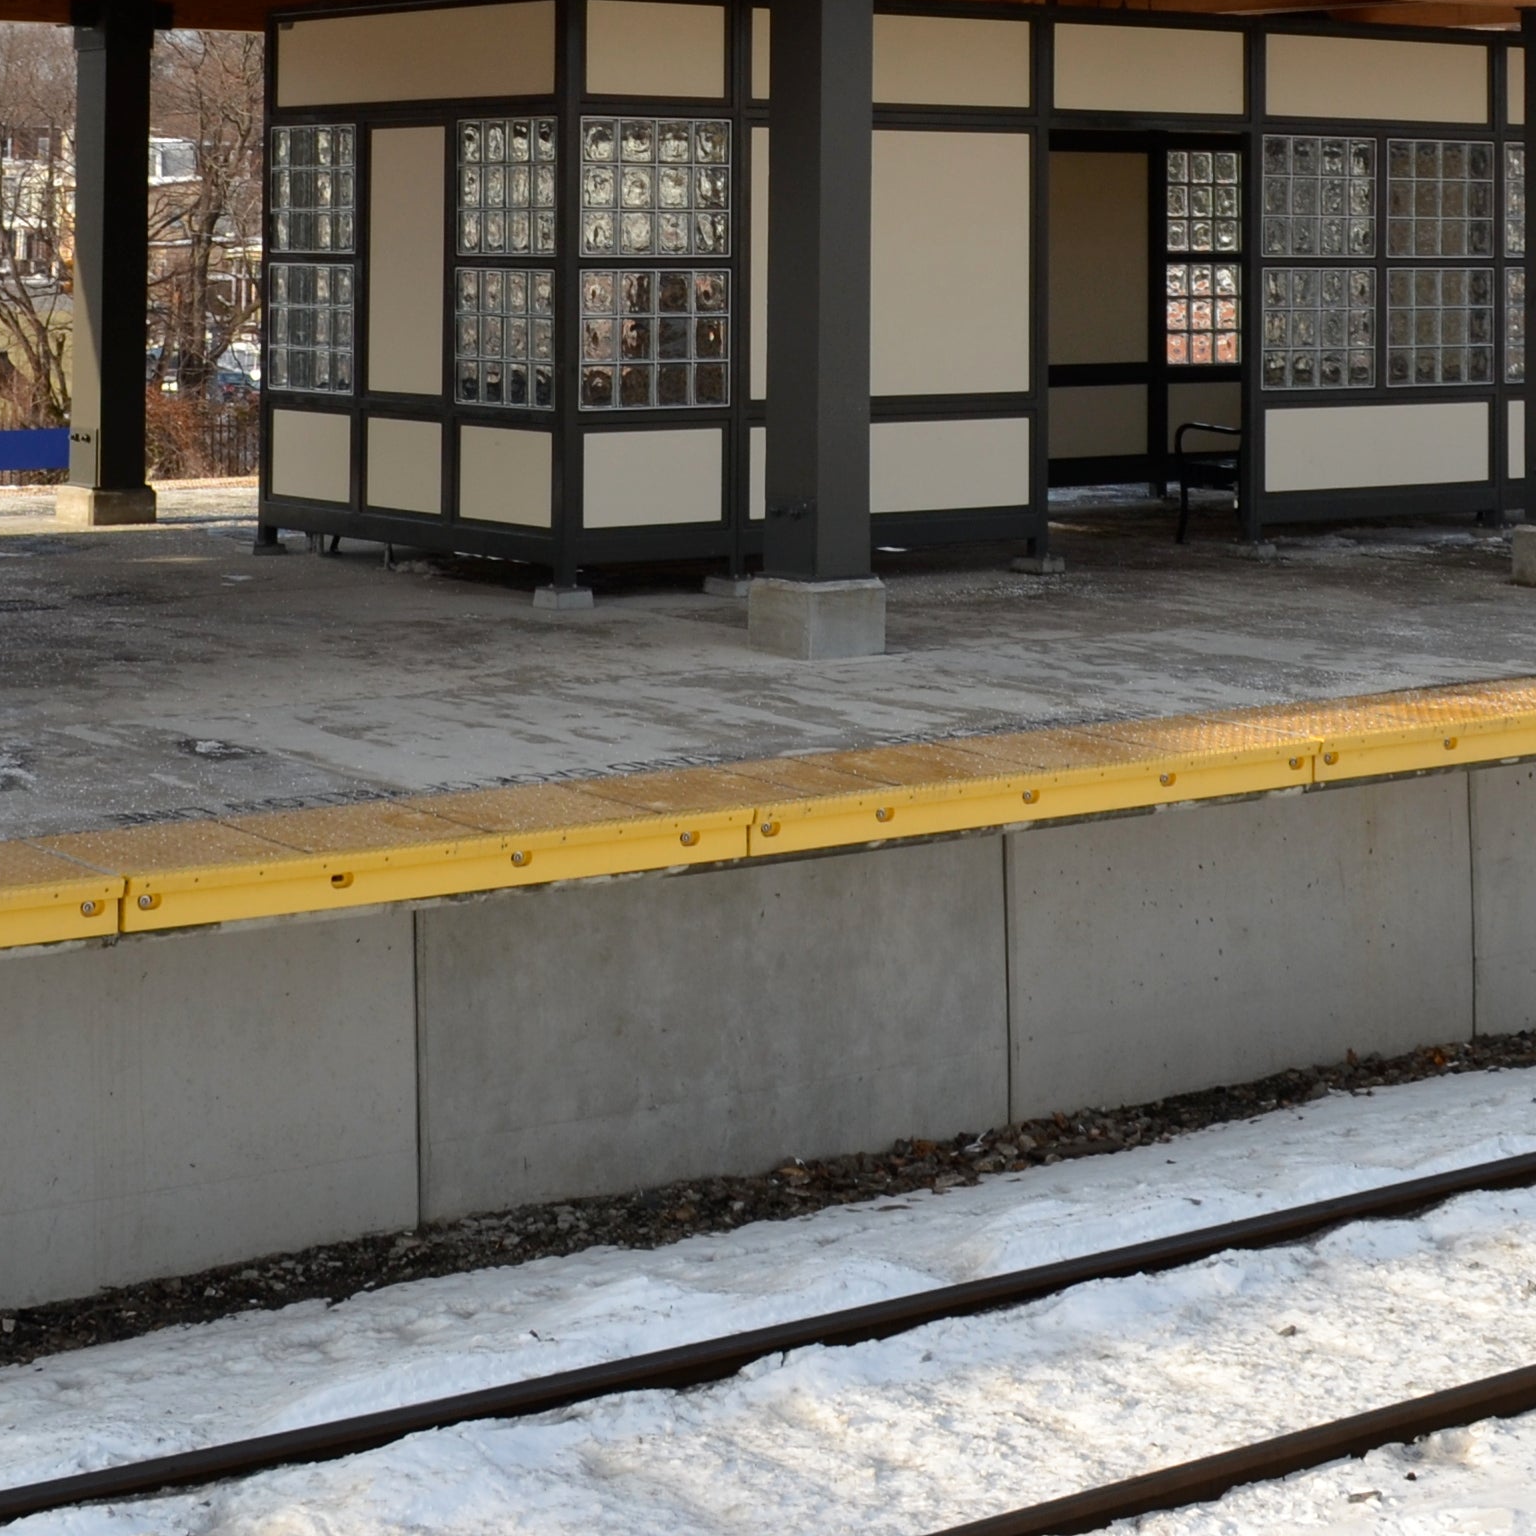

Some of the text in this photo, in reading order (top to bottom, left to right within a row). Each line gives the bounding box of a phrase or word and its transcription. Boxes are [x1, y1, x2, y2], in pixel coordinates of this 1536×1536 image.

[480, 766, 605, 786] BACK
[421, 779, 480, 794] OF
[221, 789, 414, 813] YELLOW
[101, 806, 217, 826] LINE
